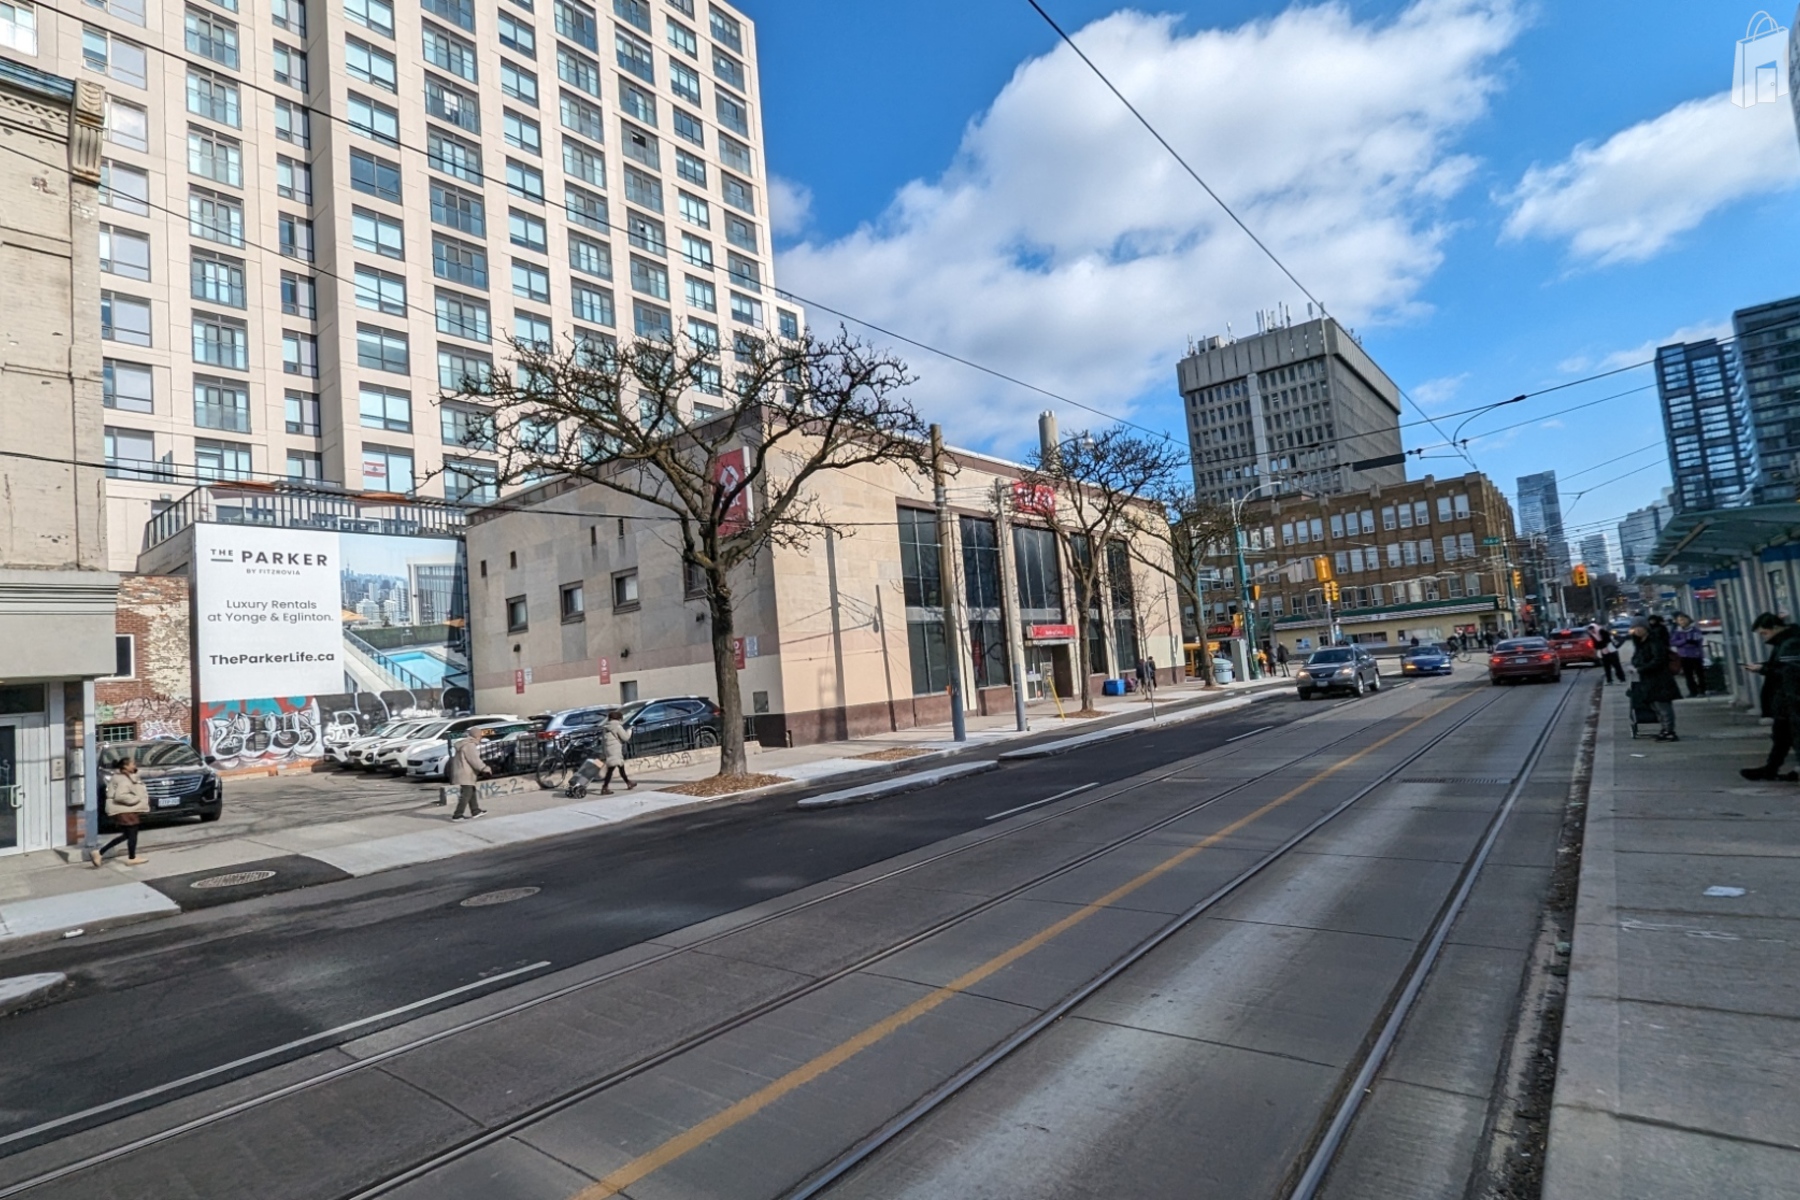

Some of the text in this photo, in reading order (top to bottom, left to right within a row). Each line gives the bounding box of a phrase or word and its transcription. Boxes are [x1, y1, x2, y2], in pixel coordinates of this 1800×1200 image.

[210, 549, 328, 567] THE PARKER
[259, 568, 301, 576] FITZROVIA
[226, 600, 318, 611] Luxury Rentals
[207, 612, 334, 624] at Yonge & Eglinton.
[209, 651, 335, 665] TheParkerLife.ca
